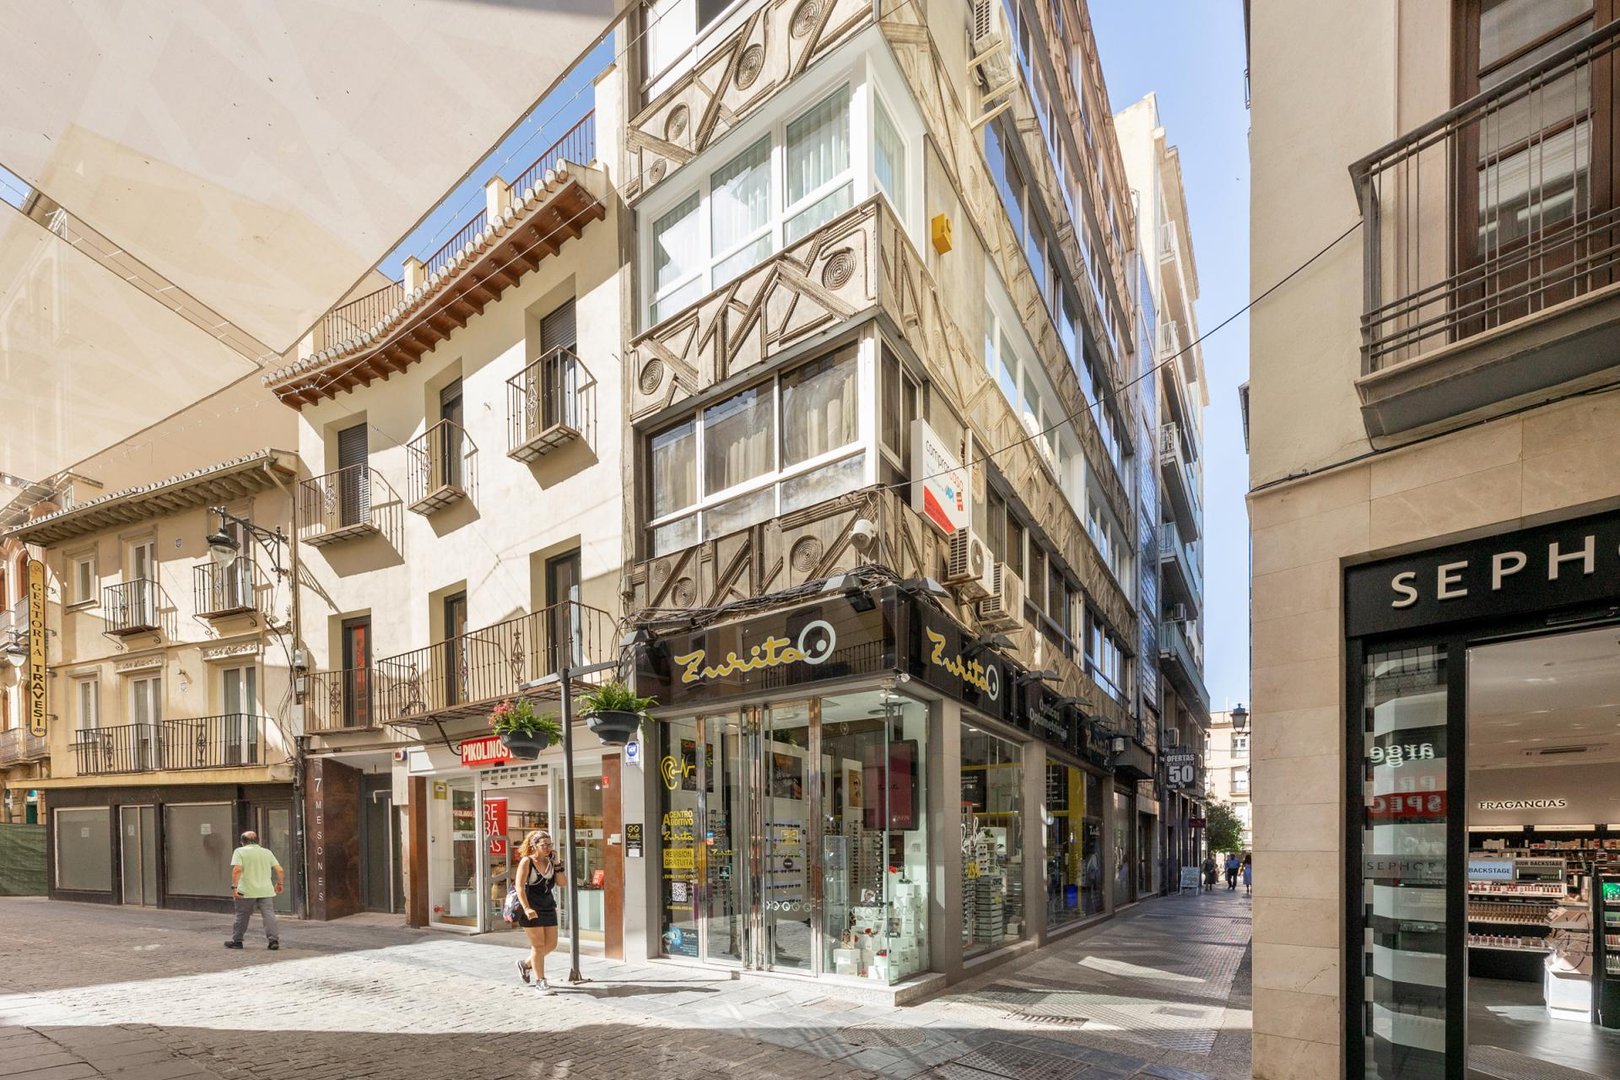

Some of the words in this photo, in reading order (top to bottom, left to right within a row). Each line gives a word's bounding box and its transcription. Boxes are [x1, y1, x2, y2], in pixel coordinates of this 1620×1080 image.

[1391, 534, 1620, 608] SEPH
[31, 583, 42, 657] GESTORIA
[673, 636, 810, 684] Zurita
[926, 625, 990, 693] Zurita
[32, 664, 44, 727] TRAVESI
[462, 739, 508, 762] PIKOLINOS
[1166, 754, 1195, 762] OFERTAS
[1169, 765, 1194, 783] 50
[314, 778, 322, 792] 7
[669, 810, 693, 818] CENTRO
[1480, 799, 1566, 809] FRAGANCIAS
[663, 813, 694, 826] AUDITIVO
[315, 801, 324, 901] MESONES
[1366, 861, 1446, 871] SEPHOR
